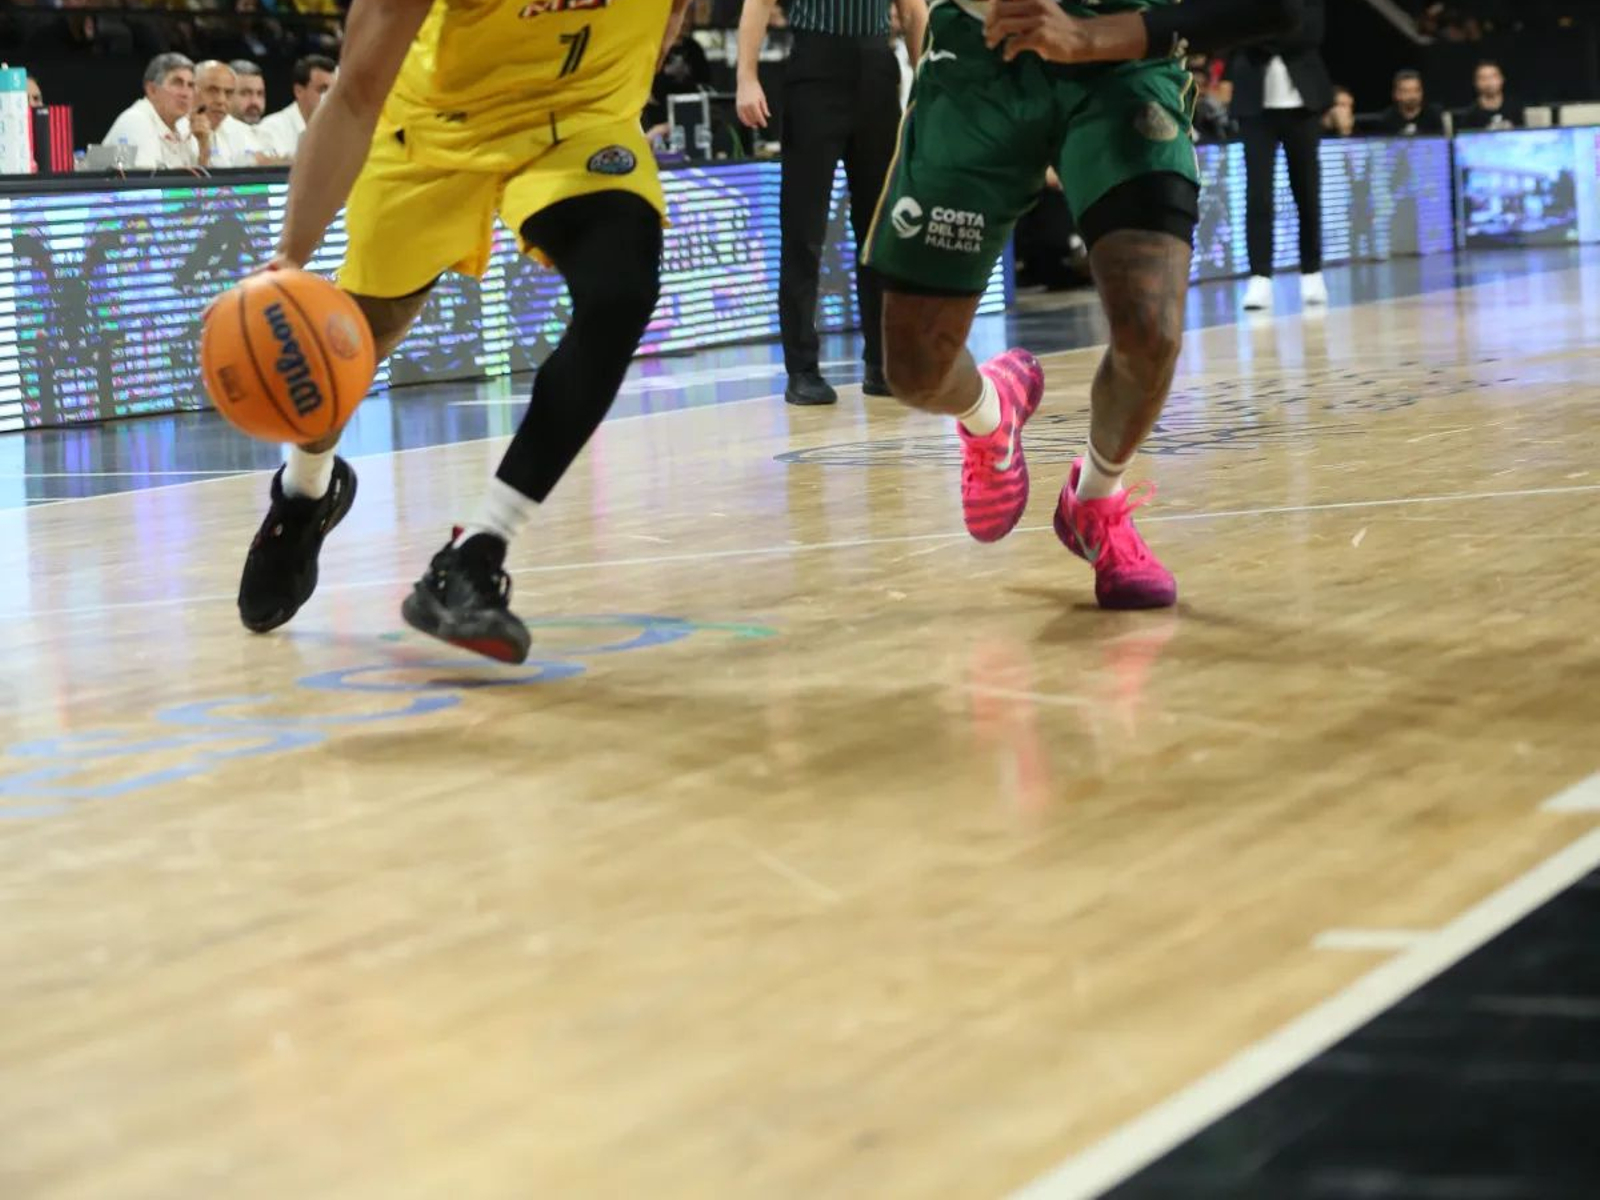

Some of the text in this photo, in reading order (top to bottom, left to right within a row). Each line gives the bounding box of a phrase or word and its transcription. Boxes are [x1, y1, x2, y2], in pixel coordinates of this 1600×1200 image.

[557, 23, 592, 80] 7
[927, 220, 983, 242] DEL SOL
[930, 205, 985, 229] COSTA
[262, 300, 324, 418] Wilson
